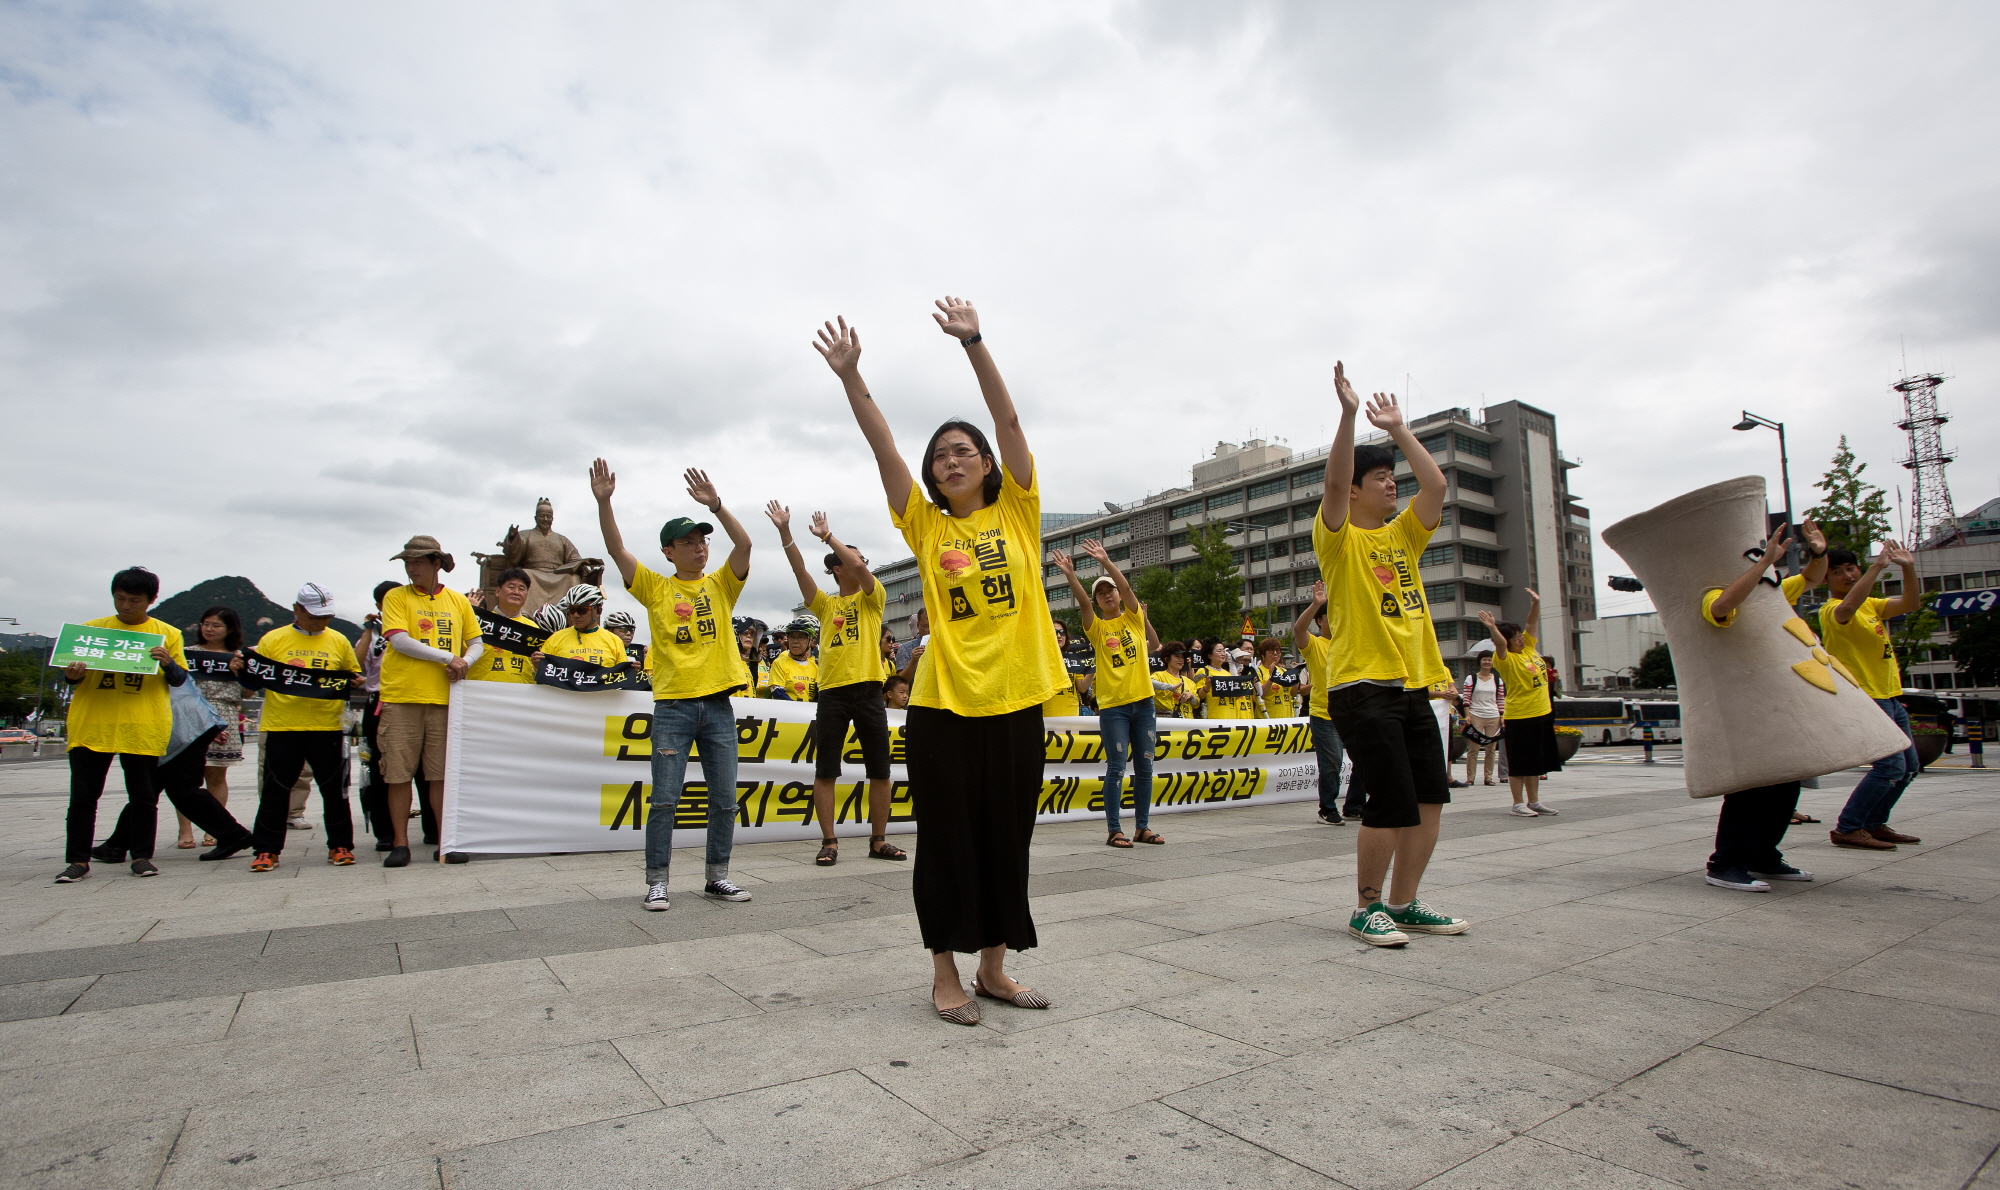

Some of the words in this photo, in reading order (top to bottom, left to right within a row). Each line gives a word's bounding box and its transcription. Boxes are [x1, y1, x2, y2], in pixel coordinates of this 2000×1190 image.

[979, 528, 1002, 541] 전에
[974, 538, 1016, 609] 탈핵
[694, 595, 717, 640] 탈핵
[75, 634, 110, 647] 사드
[113, 638, 146, 651] 가고
[72, 645, 107, 659] 평화
[110, 651, 145, 663] 오라
[203, 659, 230, 674] 말고
[247, 658, 277, 680] 원전
[282, 668, 313, 686] 말고
[317, 676, 348, 691] 안전
[545, 663, 569, 682] 원전
[573, 670, 598, 686] 말고
[601, 671, 628, 685] 안전
[1278, 765, 1303, 778] 2017년
[1155, 766, 1261, 808] 기자회견
